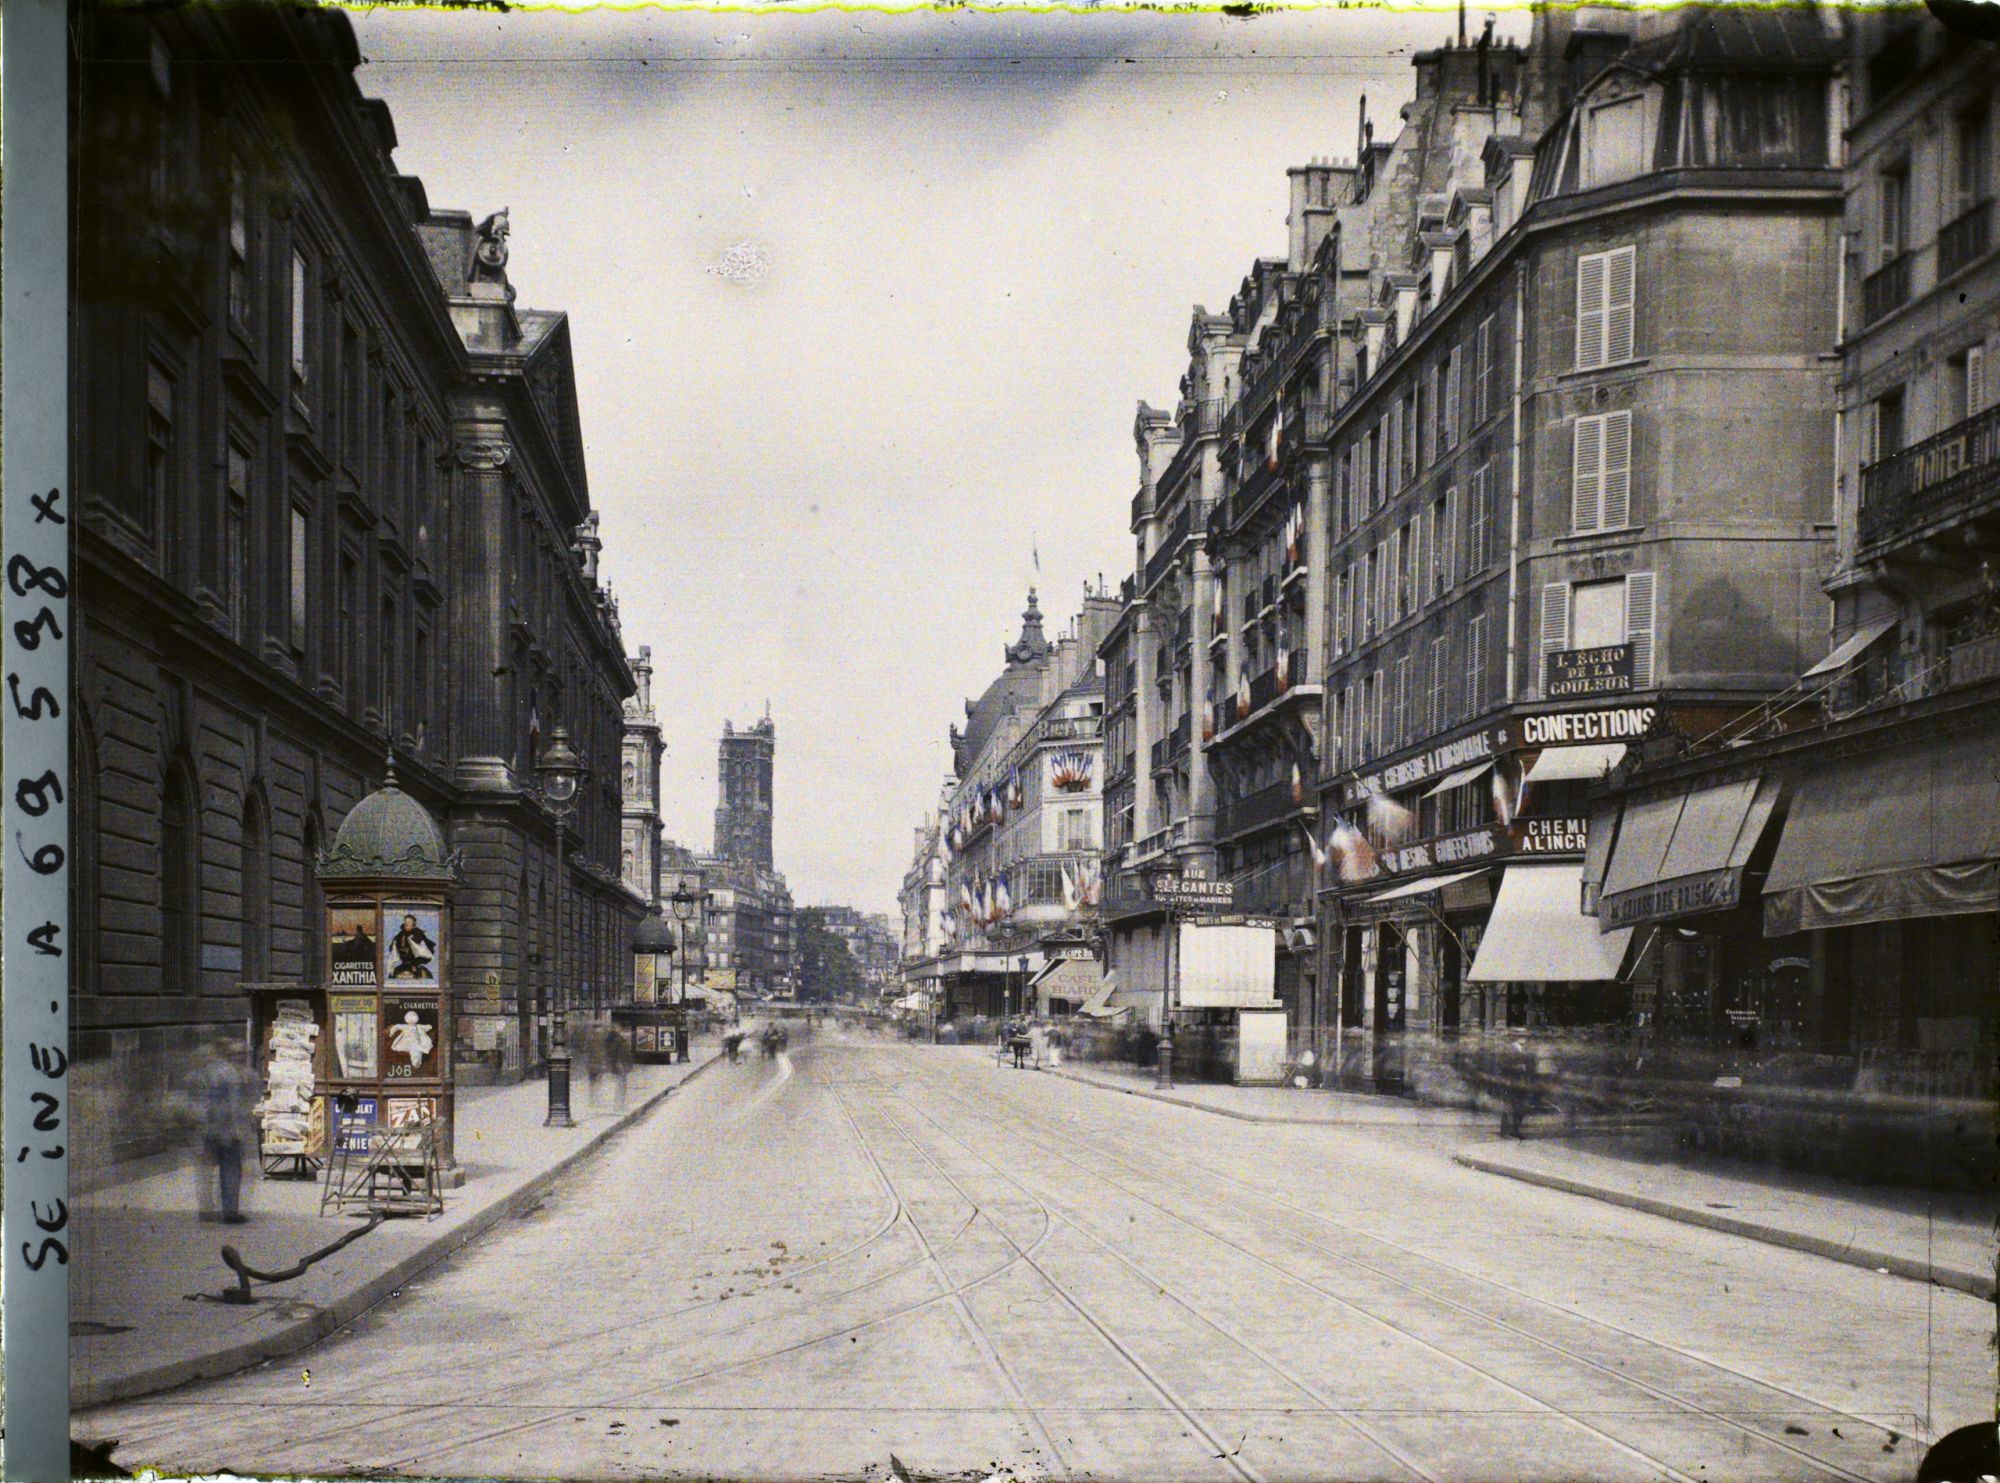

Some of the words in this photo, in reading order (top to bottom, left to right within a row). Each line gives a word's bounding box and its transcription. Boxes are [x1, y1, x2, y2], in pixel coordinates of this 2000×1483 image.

[1594, 663, 1614, 676] LA
[1550, 675, 1631, 695] COULEUR
[1523, 707, 1656, 744] CONFECTIONS
[1183, 868, 1206, 880] AUX
[333, 961, 374, 970] CIGARETTES
[332, 970, 377, 984] XANTHIA
[388, 1064, 412, 1078] JOB
